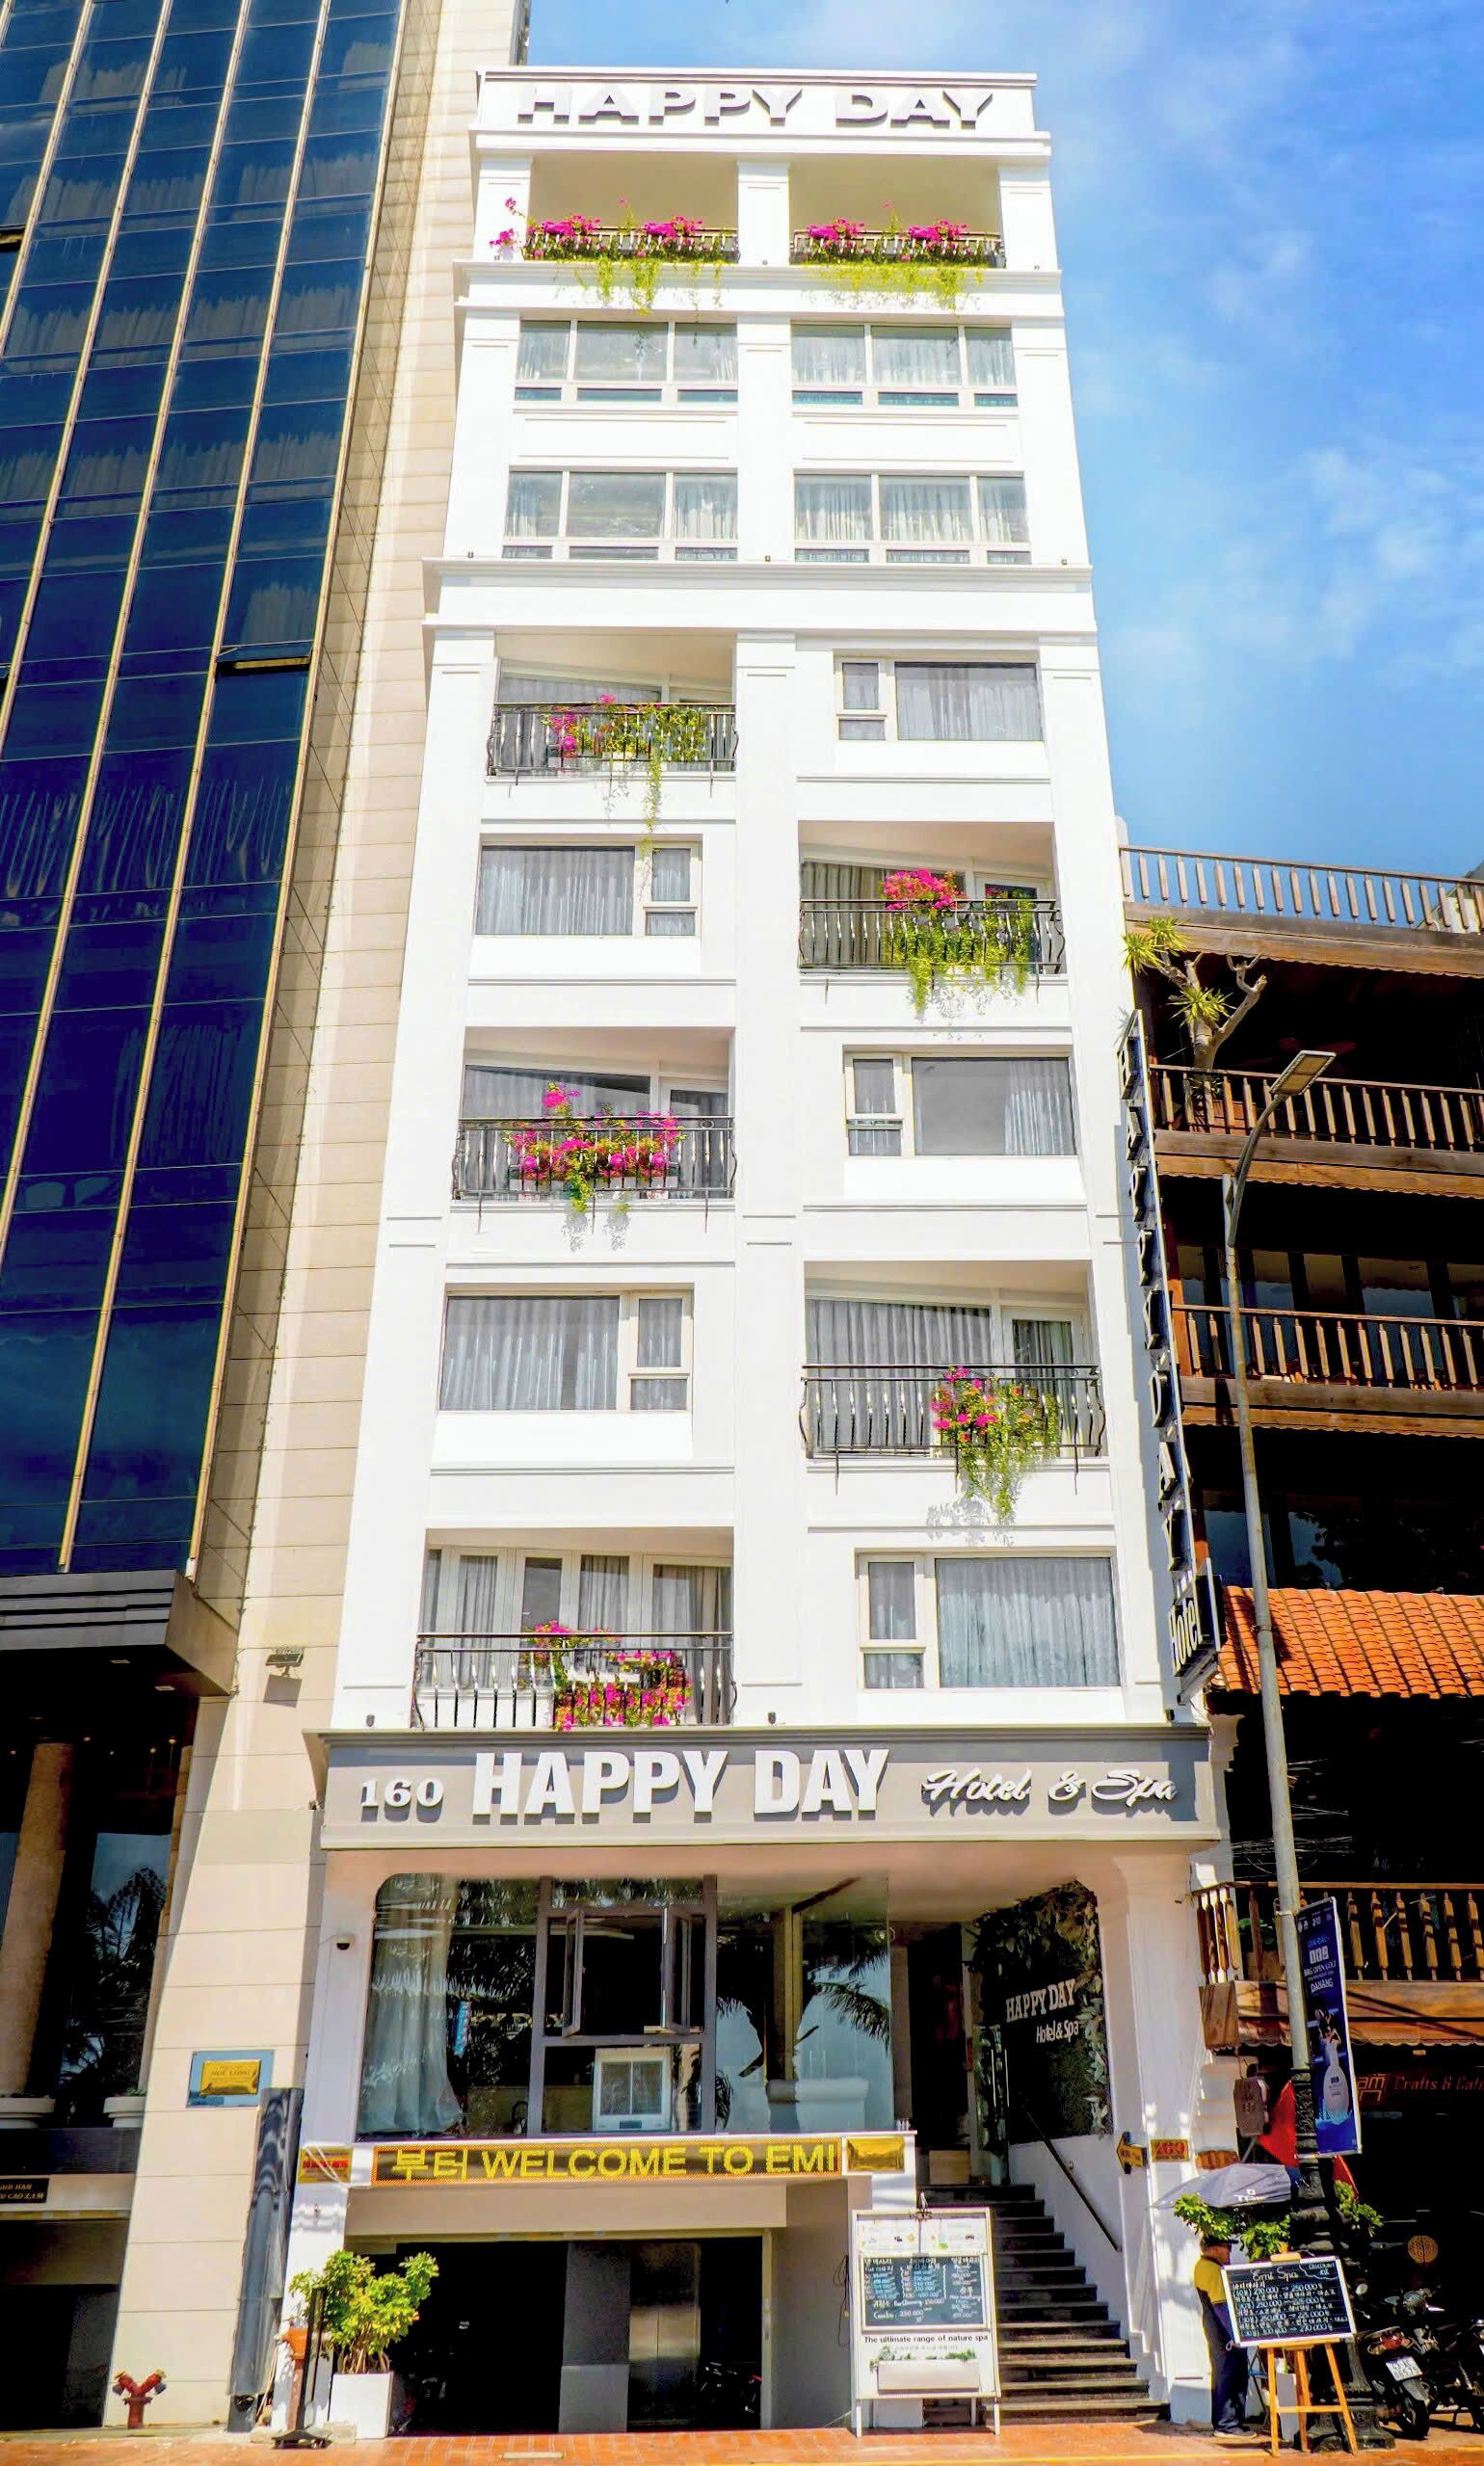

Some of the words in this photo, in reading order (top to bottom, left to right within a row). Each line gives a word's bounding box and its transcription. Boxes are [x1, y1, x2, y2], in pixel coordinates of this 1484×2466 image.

[517, 81, 803, 126] HAPPY
[835, 87, 994, 129] DAY
[1169, 1597, 1202, 1677] Hotel
[361, 1777, 444, 1808] 160
[472, 1750, 729, 1816] HAPPY
[753, 1748, 889, 1815] DAY
[921, 1767, 1032, 1801] Hotel
[1047, 1770, 1087, 1801] &
[1091, 1769, 1178, 1808] Spa
[1005, 1988, 1047, 2023] HAPPY
[1047, 1978, 1075, 2011] DAY
[392, 2148, 466, 2180] 부터
[482, 2146, 687, 2178] WELCOME
[699, 2145, 754, 2175] TO
[766, 2143, 835, 2172] EMI
[1276, 2266, 1299, 2282] Spa
